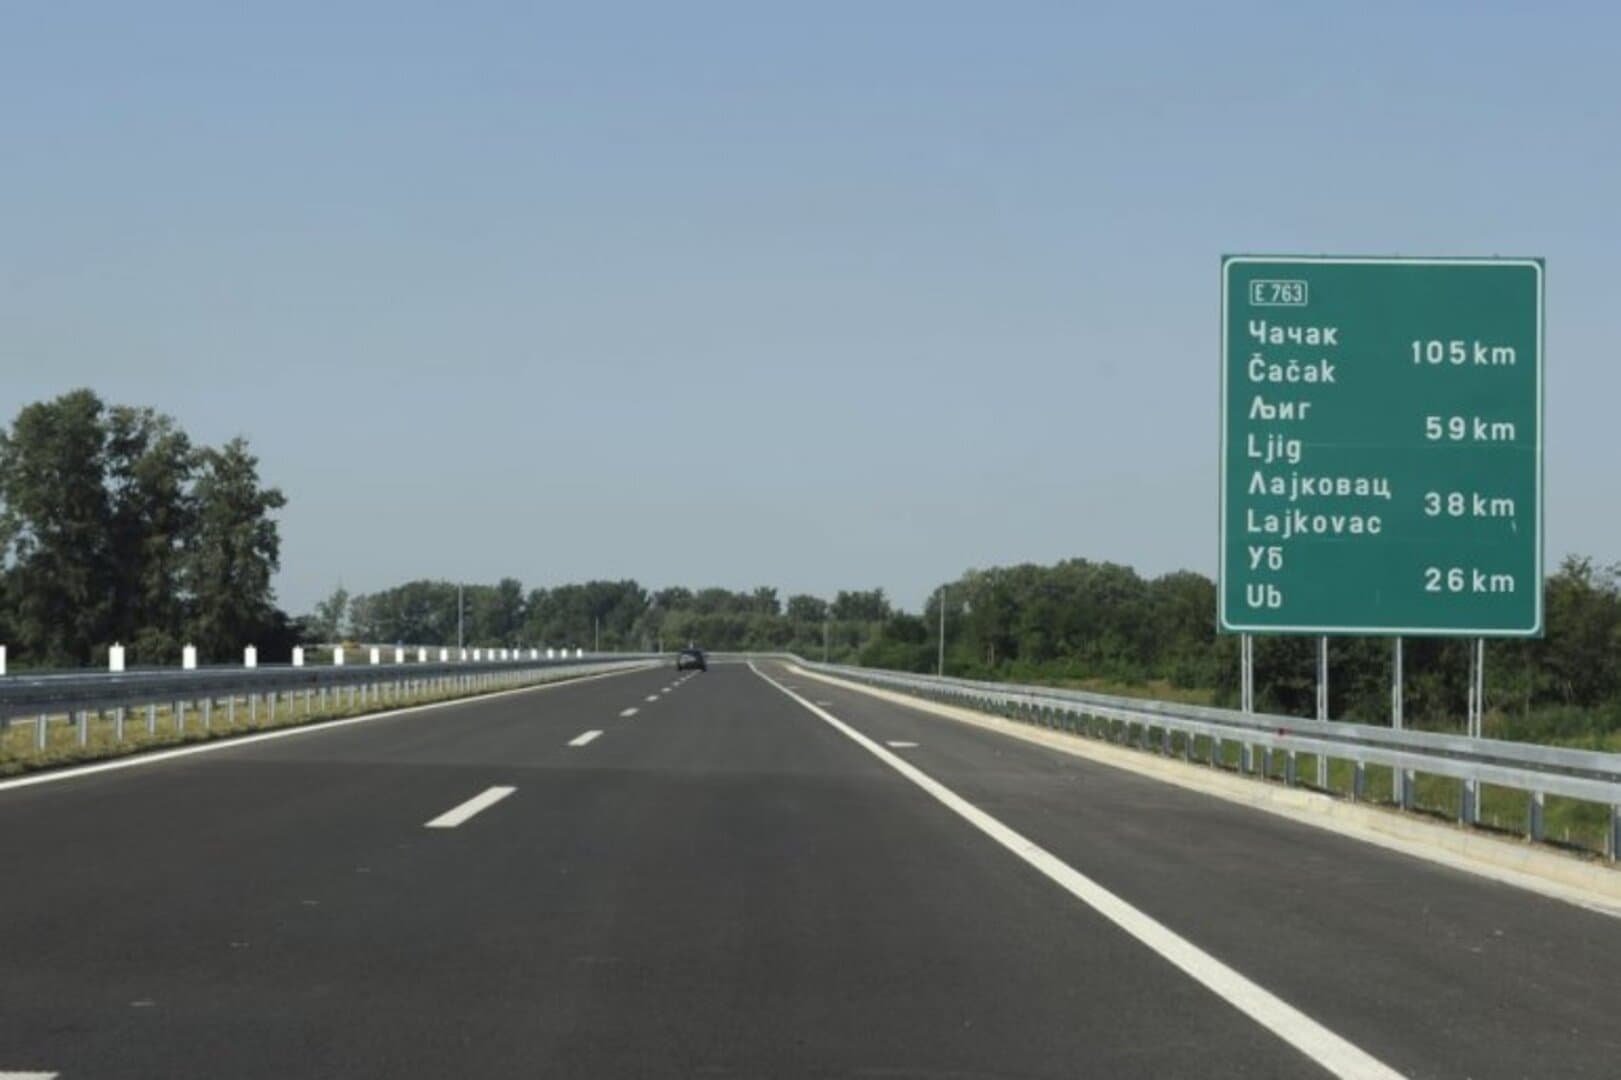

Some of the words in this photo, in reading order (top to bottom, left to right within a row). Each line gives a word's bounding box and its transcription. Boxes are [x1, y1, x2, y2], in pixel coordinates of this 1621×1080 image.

[1254, 283, 1265, 303] E
[1271, 284, 1303, 303] 763
[1249, 320, 1337, 345] Чачак
[1248, 353, 1336, 383] Čačak
[1249, 395, 1311, 420] Љиг
[1247, 434, 1302, 463] Ljig
[1249, 471, 1392, 500] Лајковац
[1247, 508, 1382, 538] Lajkovac
[1248, 545, 1283, 570] Уб
[1246, 584, 1283, 608] Ub
